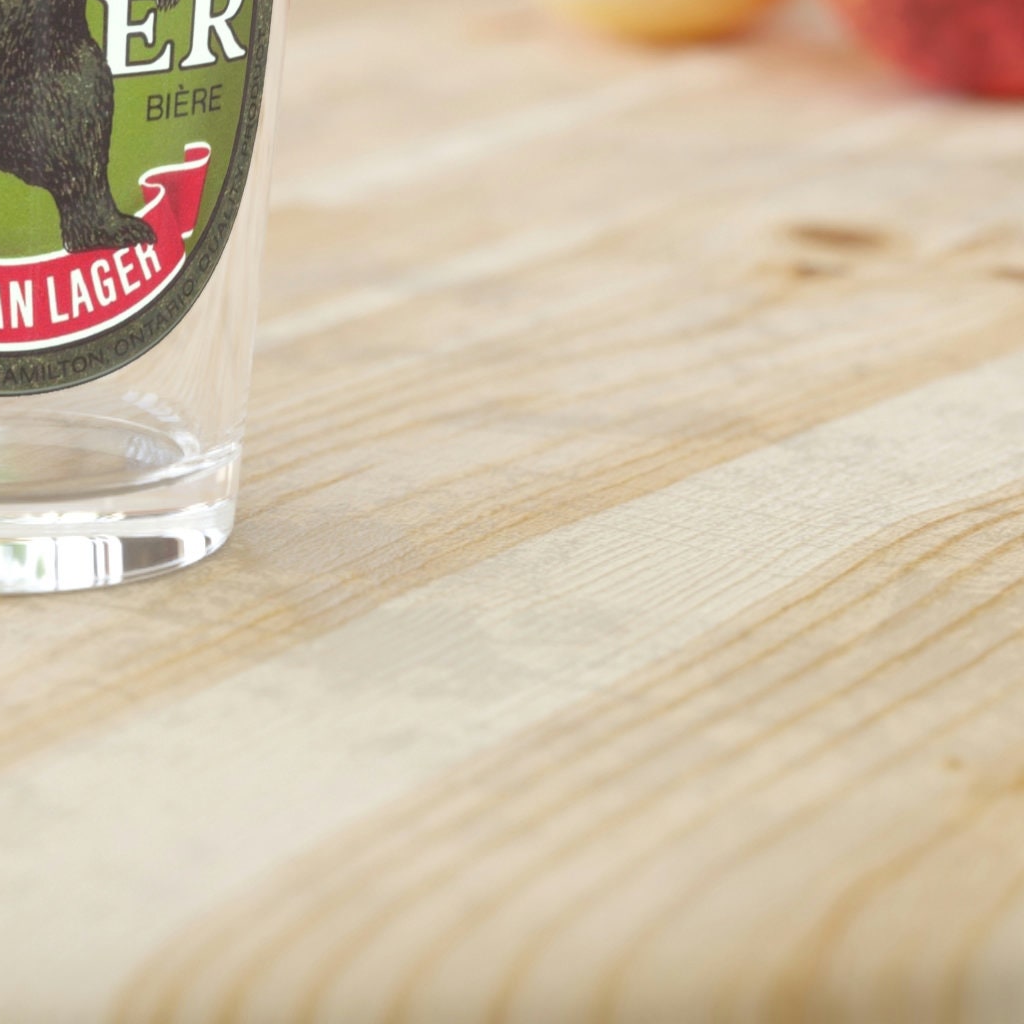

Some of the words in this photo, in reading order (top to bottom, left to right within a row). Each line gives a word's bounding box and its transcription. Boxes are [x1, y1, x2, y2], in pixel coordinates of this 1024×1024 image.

[145, 83, 223, 122] BIÈRE
[197, 165, 244, 273] QUALITY
[240, 29, 268, 157] PRODUCT
[45, 242, 163, 324] LAGER
